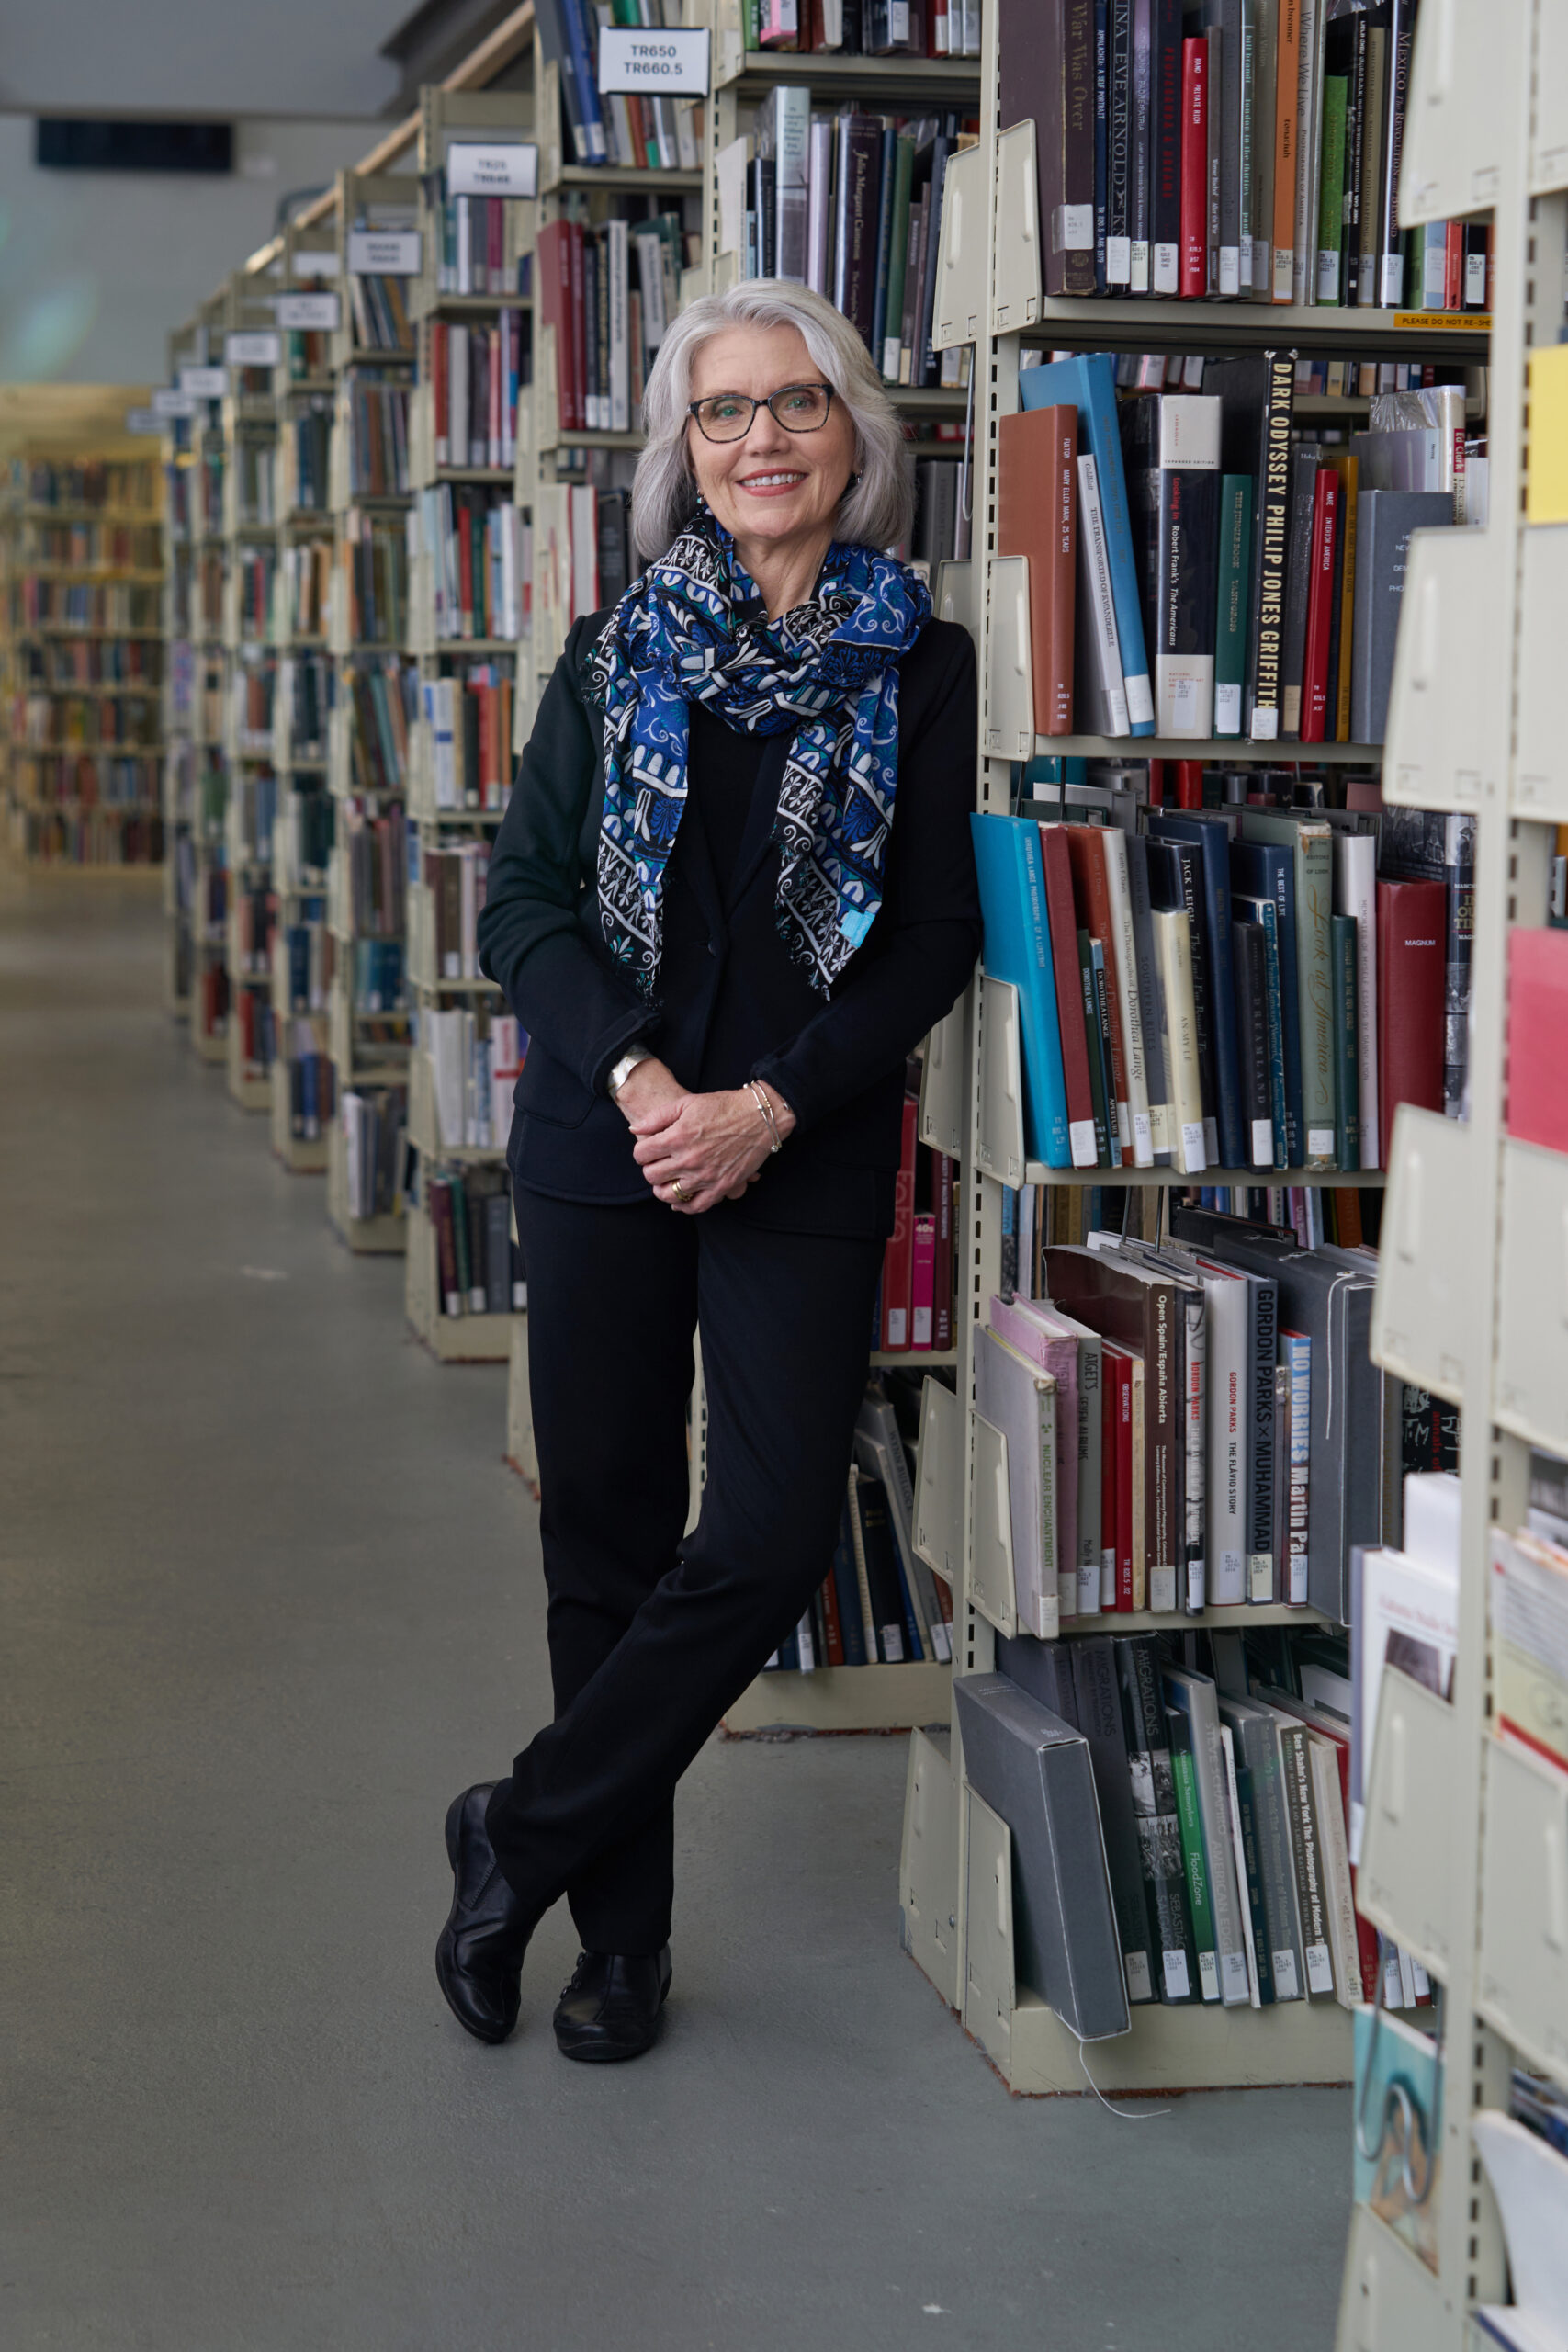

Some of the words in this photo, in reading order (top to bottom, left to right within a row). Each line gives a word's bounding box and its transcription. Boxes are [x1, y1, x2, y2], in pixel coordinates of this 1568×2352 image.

[1072, 4, 1087, 38] War
[1286, 7, 1295, 44] brenner
[1299, 11, 1313, 58] Where
[631, 45, 676, 57] TR650
[1072, 44, 1087, 80] Was
[1097, 30, 1105, 65] APPALACHIA:
[1396, 32, 1412, 91] MEXICO
[625, 62, 682, 74] TR660.5
[1115, 54, 1127, 92] EVE
[1244, 53, 1252, 83] brandt
[1298, 63, 1311, 85] We
[1163, 47, 1174, 128] PROPAGANDA
[1297, 89, 1309, 117] Live
[1395, 96, 1404, 110] The
[1071, 86, 1087, 130] Over
[1113, 96, 1126, 184] ARNOLD
[1243, 147, 1251, 161] the
[1244, 135, 1251, 143] in
[1282, 119, 1292, 158] tonatiuh
[1392, 112, 1404, 176] REVOLUTION
[852, 153, 868, 174] Julia
[1163, 151, 1174, 198] DREAMS
[853, 176, 865, 216] Margaret
[1298, 195, 1306, 226] AMERICA
[1390, 197, 1400, 238] BEYOND
[853, 220, 863, 260] Cameron
[1271, 363, 1292, 409] DARK
[1063, 438, 1071, 459] FULTON
[1455, 431, 1464, 442] Ed
[1268, 417, 1290, 495] ODYSSEY
[1455, 445, 1464, 469] Clark
[1063, 469, 1071, 484] MARY
[1083, 463, 1094, 491] Goldblatt
[1170, 477, 1181, 506] Looking
[1061, 506, 1070, 524] MARK,
[1090, 507, 1099, 523] THE
[1172, 511, 1180, 519] in
[1325, 492, 1334, 506] HARE
[1062, 526, 1069, 534] 25
[1171, 526, 1180, 552] Robert
[1234, 511, 1242, 542] JUNGLE
[1264, 505, 1285, 564] PHILIP
[1324, 517, 1332, 544] INTERIOR
[1091, 524, 1106, 582] TRANSPORTED
[1170, 555, 1179, 584] Frank's
[1322, 546, 1331, 571] AMERICA
[1099, 584, 1108, 594] OF
[1169, 588, 1179, 602] The
[1261, 571, 1283, 624] JONES
[1100, 595, 1115, 647] KWANDEBELE
[1168, 605, 1178, 646] Americans
[1118, 853, 1126, 868] Keith
[1181, 858, 1192, 884] JACK
[1277, 868, 1285, 878] THE
[1278, 880, 1286, 894] BEST
[1184, 888, 1195, 922] LEIGH
[1279, 904, 1287, 917] LIFE
[1123, 921, 1132, 933] The
[1306, 885, 1330, 960] Look
[1124, 934, 1134, 976] Photographs
[1083, 968, 1092, 996] DOROTHEA
[1097, 970, 1108, 1009] DOROTHEA
[1141, 956, 1155, 1016] SOUTHERN
[1315, 970, 1328, 990] at
[1085, 998, 1094, 1014] LANGE
[1127, 990, 1143, 1043] Dorothea
[1100, 1009, 1110, 1038] LANGE
[1146, 1022, 1157, 1051] RITES
[1180, 1016, 1190, 1046] AN-MY
[1308, 976, 1330, 1076] America
[1129, 1047, 1145, 1080] Lange
[1183, 1049, 1192, 1061] LÉ
[1253, 998, 1267, 1102] DREAMLAND
[1109, 1098, 1118, 1135] APERTURE
[1157, 1295, 1168, 1320] Open
[1257, 1289, 1275, 1360] GORDON
[1156, 1322, 1168, 1386] Spain/España
[1084, 1352, 1099, 1390] ATGET'S
[1078, 1396, 1088, 1422] SEVEN
[1122, 1384, 1130, 1422] OBSERVATIONS
[1158, 1388, 1168, 1424] Abierta
[1257, 1366, 1273, 1423] PARKS
[1291, 1378, 1310, 1464] WORRIES
[1432, 1411, 1441, 1453] annals
[889, 1430, 900, 1464] WYNN
[1078, 1425, 1089, 1460] ALBUMS
[1228, 1442, 1236, 1457] THE
[1043, 1444, 1052, 1491] NUCLEAR
[1228, 1459, 1238, 1487] FLÁVIO
[1433, 1457, 1441, 1470] of
[1255, 1442, 1271, 1551] MUHAMMAD
[1290, 1465, 1309, 1528] Martin
[1043, 1495, 1054, 1567] ENCHANTMENT
[1290, 1532, 1307, 1554] Pa
[1136, 1649, 1158, 1736] MIGRATIONS
[1204, 1723, 1219, 1763] STEVE
[1292, 1734, 1303, 1749] Ben
[1179, 1749, 1190, 1784] Anastasia
[1294, 1751, 1308, 1783] Shahn's
[1181, 1786, 1195, 1827] Samoylova
[1210, 1767, 1226, 1836] SCHAPIRO
[1299, 1785, 1310, 1802] New
[1301, 1804, 1312, 1823] York
[1303, 1824, 1314, 1841] The
[1190, 1852, 1203, 1905] FloodZone
[1210, 1839, 1227, 1911] AMERICAN
[1303, 1843, 1319, 1893] Photography
[1310, 1894, 1321, 1904] of
[1219, 1918, 1231, 1955] EDGE
[1312, 1905, 1324, 1935] Modern
